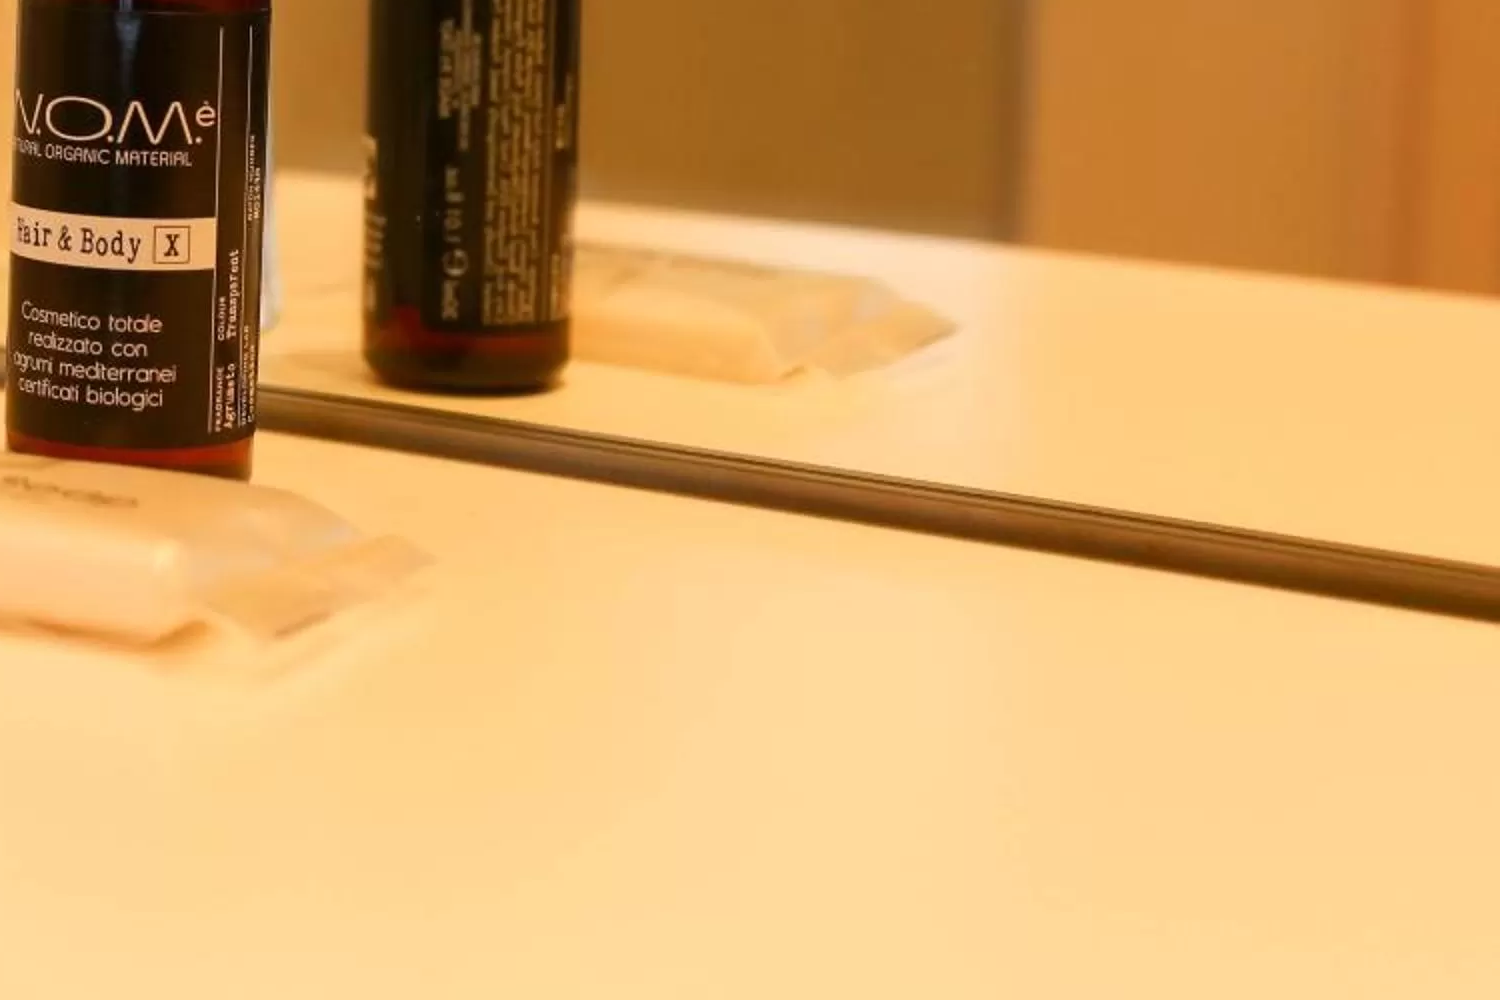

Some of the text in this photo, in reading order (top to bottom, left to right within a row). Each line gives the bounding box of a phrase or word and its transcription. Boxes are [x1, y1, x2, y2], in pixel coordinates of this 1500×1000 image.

[45, 143, 110, 166] ORGANIC
[115, 149, 193, 168] MATERIAL
[57, 225, 73, 251] &
[80, 227, 141, 264] Body
[162, 233, 181, 257] X
[225, 248, 241, 341] Transparent
[20, 300, 164, 334] Cosmetico totale
[216, 296, 227, 342] COLOUR
[27, 329, 148, 358] realizzato con
[13, 350, 177, 384] agrumi mediterranei
[17, 376, 164, 412] certificati biologici
